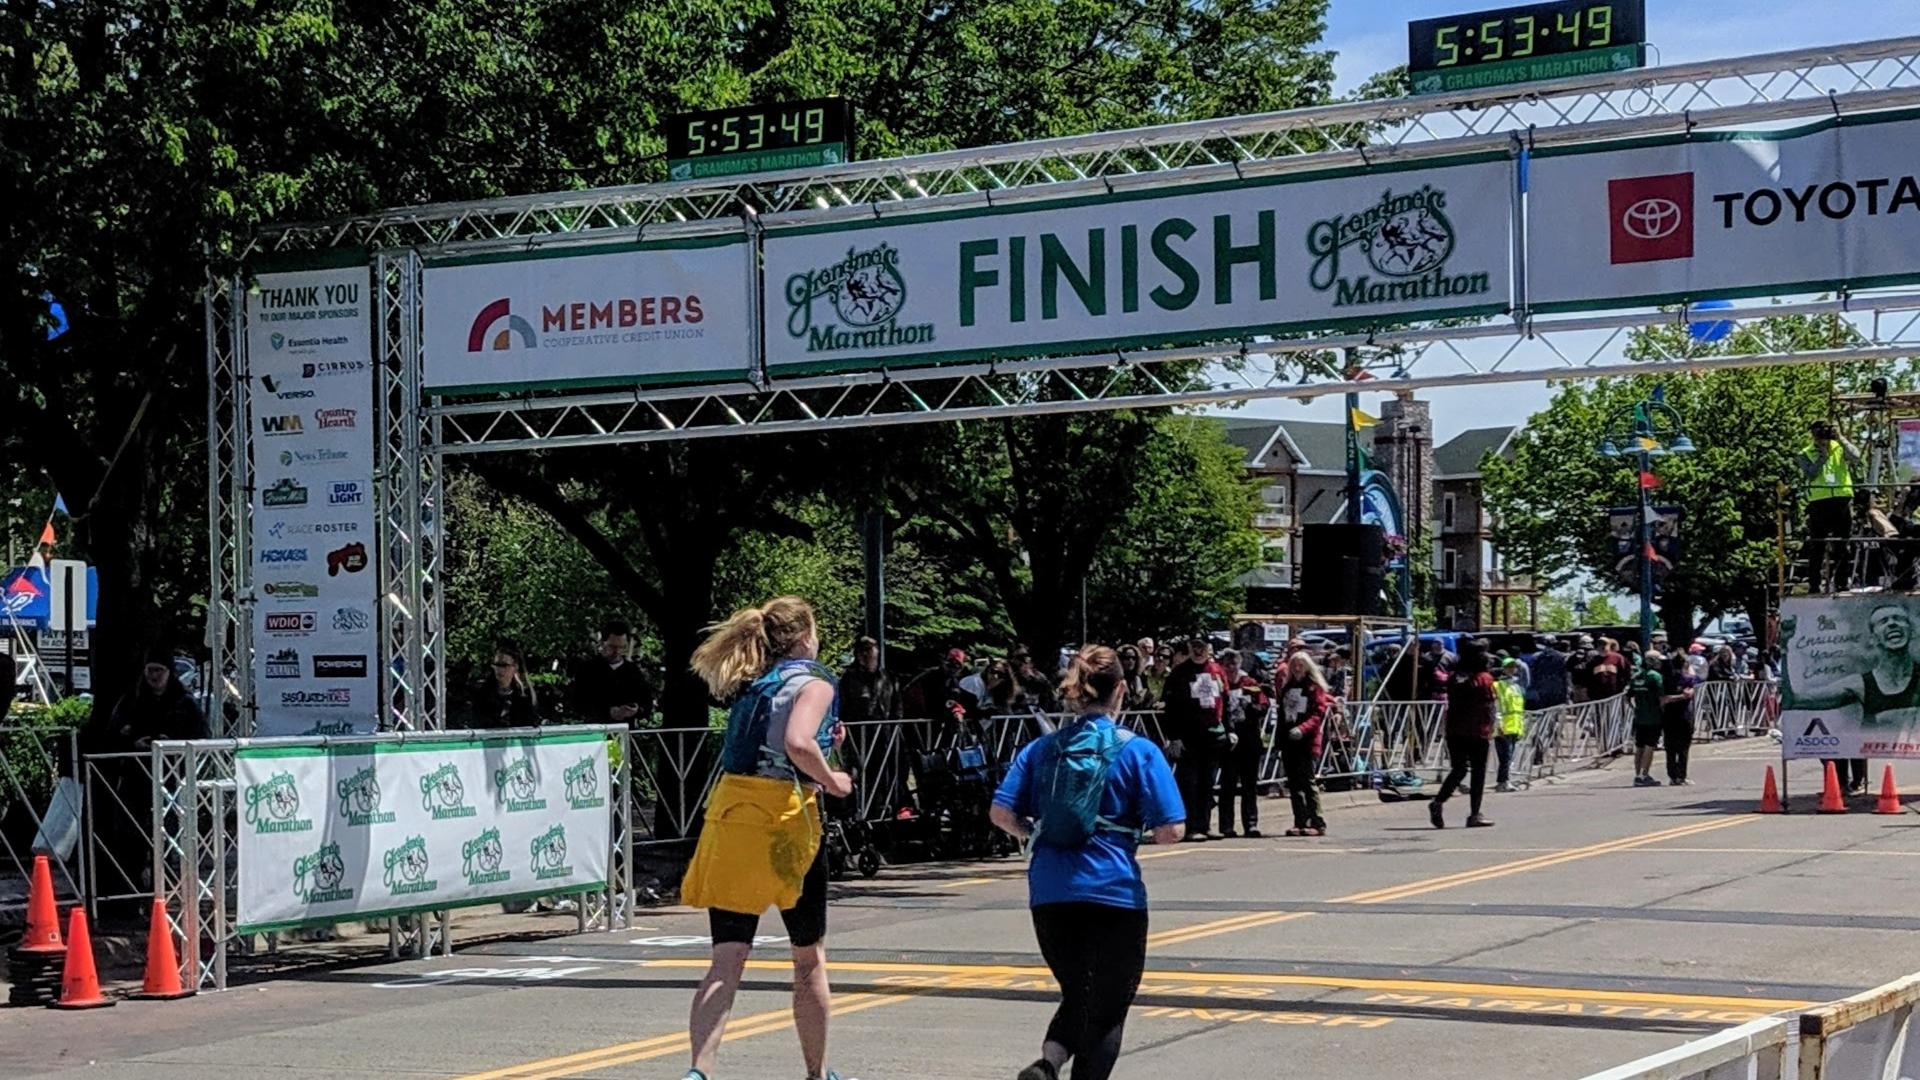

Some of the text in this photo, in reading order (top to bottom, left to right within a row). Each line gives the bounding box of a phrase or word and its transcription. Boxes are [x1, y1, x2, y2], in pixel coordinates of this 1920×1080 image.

[1446, 56, 1608, 90] GRANDMA'S MARATHON
[694, 151, 821, 177] GRANDMA'S MARATHON
[1713, 176, 1920, 228] TOYOTA
[959, 209, 1277, 327] FINISH
[1332, 268, 1490, 306] Marathon
[260, 283, 359, 309] THANK YOU
[260, 308, 359, 322] TO OUR MAJOR SPONSORS
[542, 294, 704, 332] MEMBERS
[288, 336, 348, 347] Essentia Health
[543, 328, 704, 348] COOPERATIVE CREDIT UNION
[806, 318, 935, 351] Marathon
[318, 361, 364, 372] CIRRUS
[277, 390, 314, 400] VERSO
[315, 408, 357, 421] Country
[319, 417, 356, 429] Hearth
[334, 483, 357, 493] BUD
[330, 492, 362, 504] LIGHT
[268, 617, 299, 628] WDIO
[1795, 737, 1840, 746] ASDCO
[507, 797, 546, 812] Marathon
[571, 796, 604, 810] Marathon
[348, 811, 396, 826] Marathon
[432, 804, 476, 820] Marathon
[256, 815, 312, 833] Marathon
[469, 866, 510, 885] Marathon
[536, 866, 573, 880] Marathon
[391, 875, 437, 895] Marathon
[302, 885, 353, 904] Marathon
[1364, 993, 1772, 1022] MARATHO
